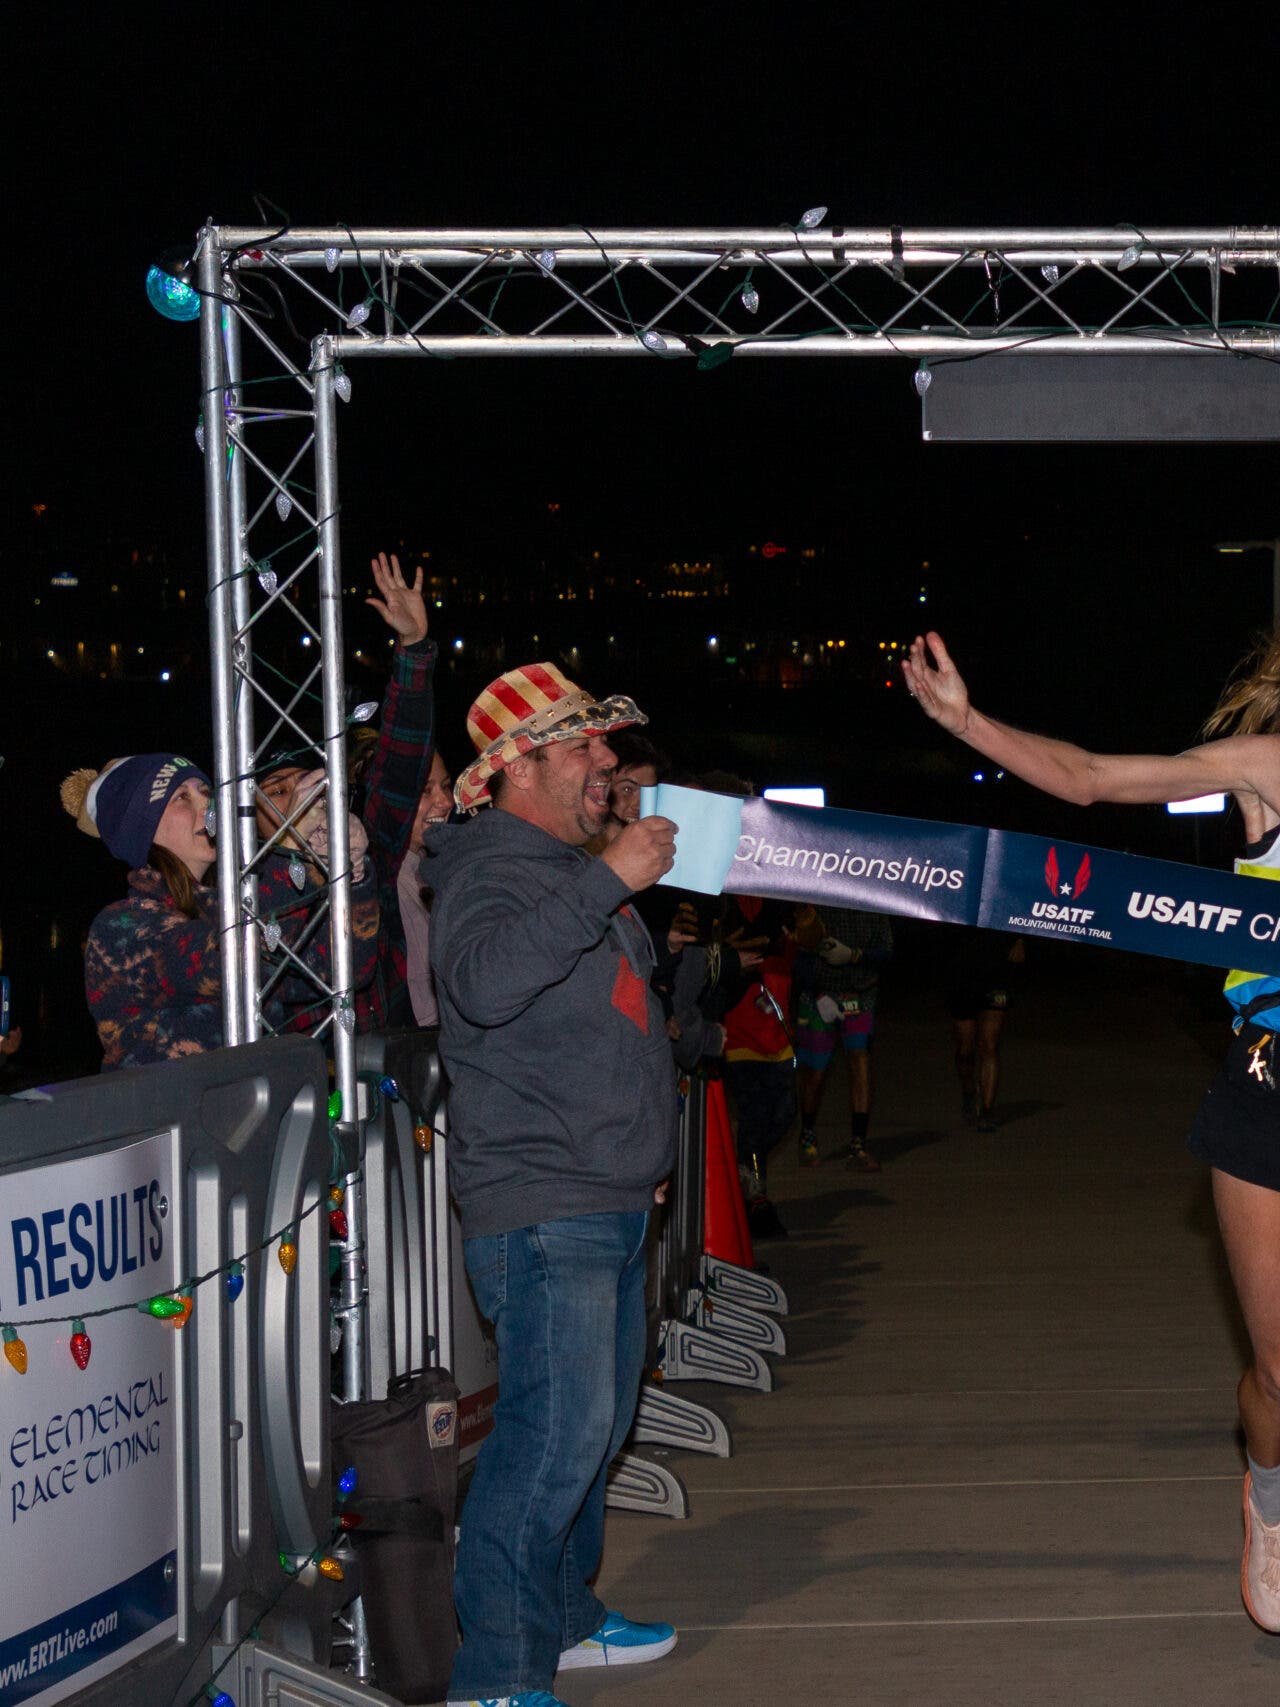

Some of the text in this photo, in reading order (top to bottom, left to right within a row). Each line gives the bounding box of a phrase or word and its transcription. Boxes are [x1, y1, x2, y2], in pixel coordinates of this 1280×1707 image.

[149, 763, 178, 803] NEW
[734, 835, 964, 892] Championships
[1008, 916, 1113, 940] MOUNTAIN ULTRA TRAIL
[1031, 902, 1095, 924] USATF
[1127, 891, 1243, 933] USATF
[11, 1179, 164, 1307] RESULTS
[10, 1372, 168, 1468] ELEMENTAL
[12, 1420, 160, 1524] RACE TIMING
[0, 1611, 118, 1689] ww.ERTLive.com
